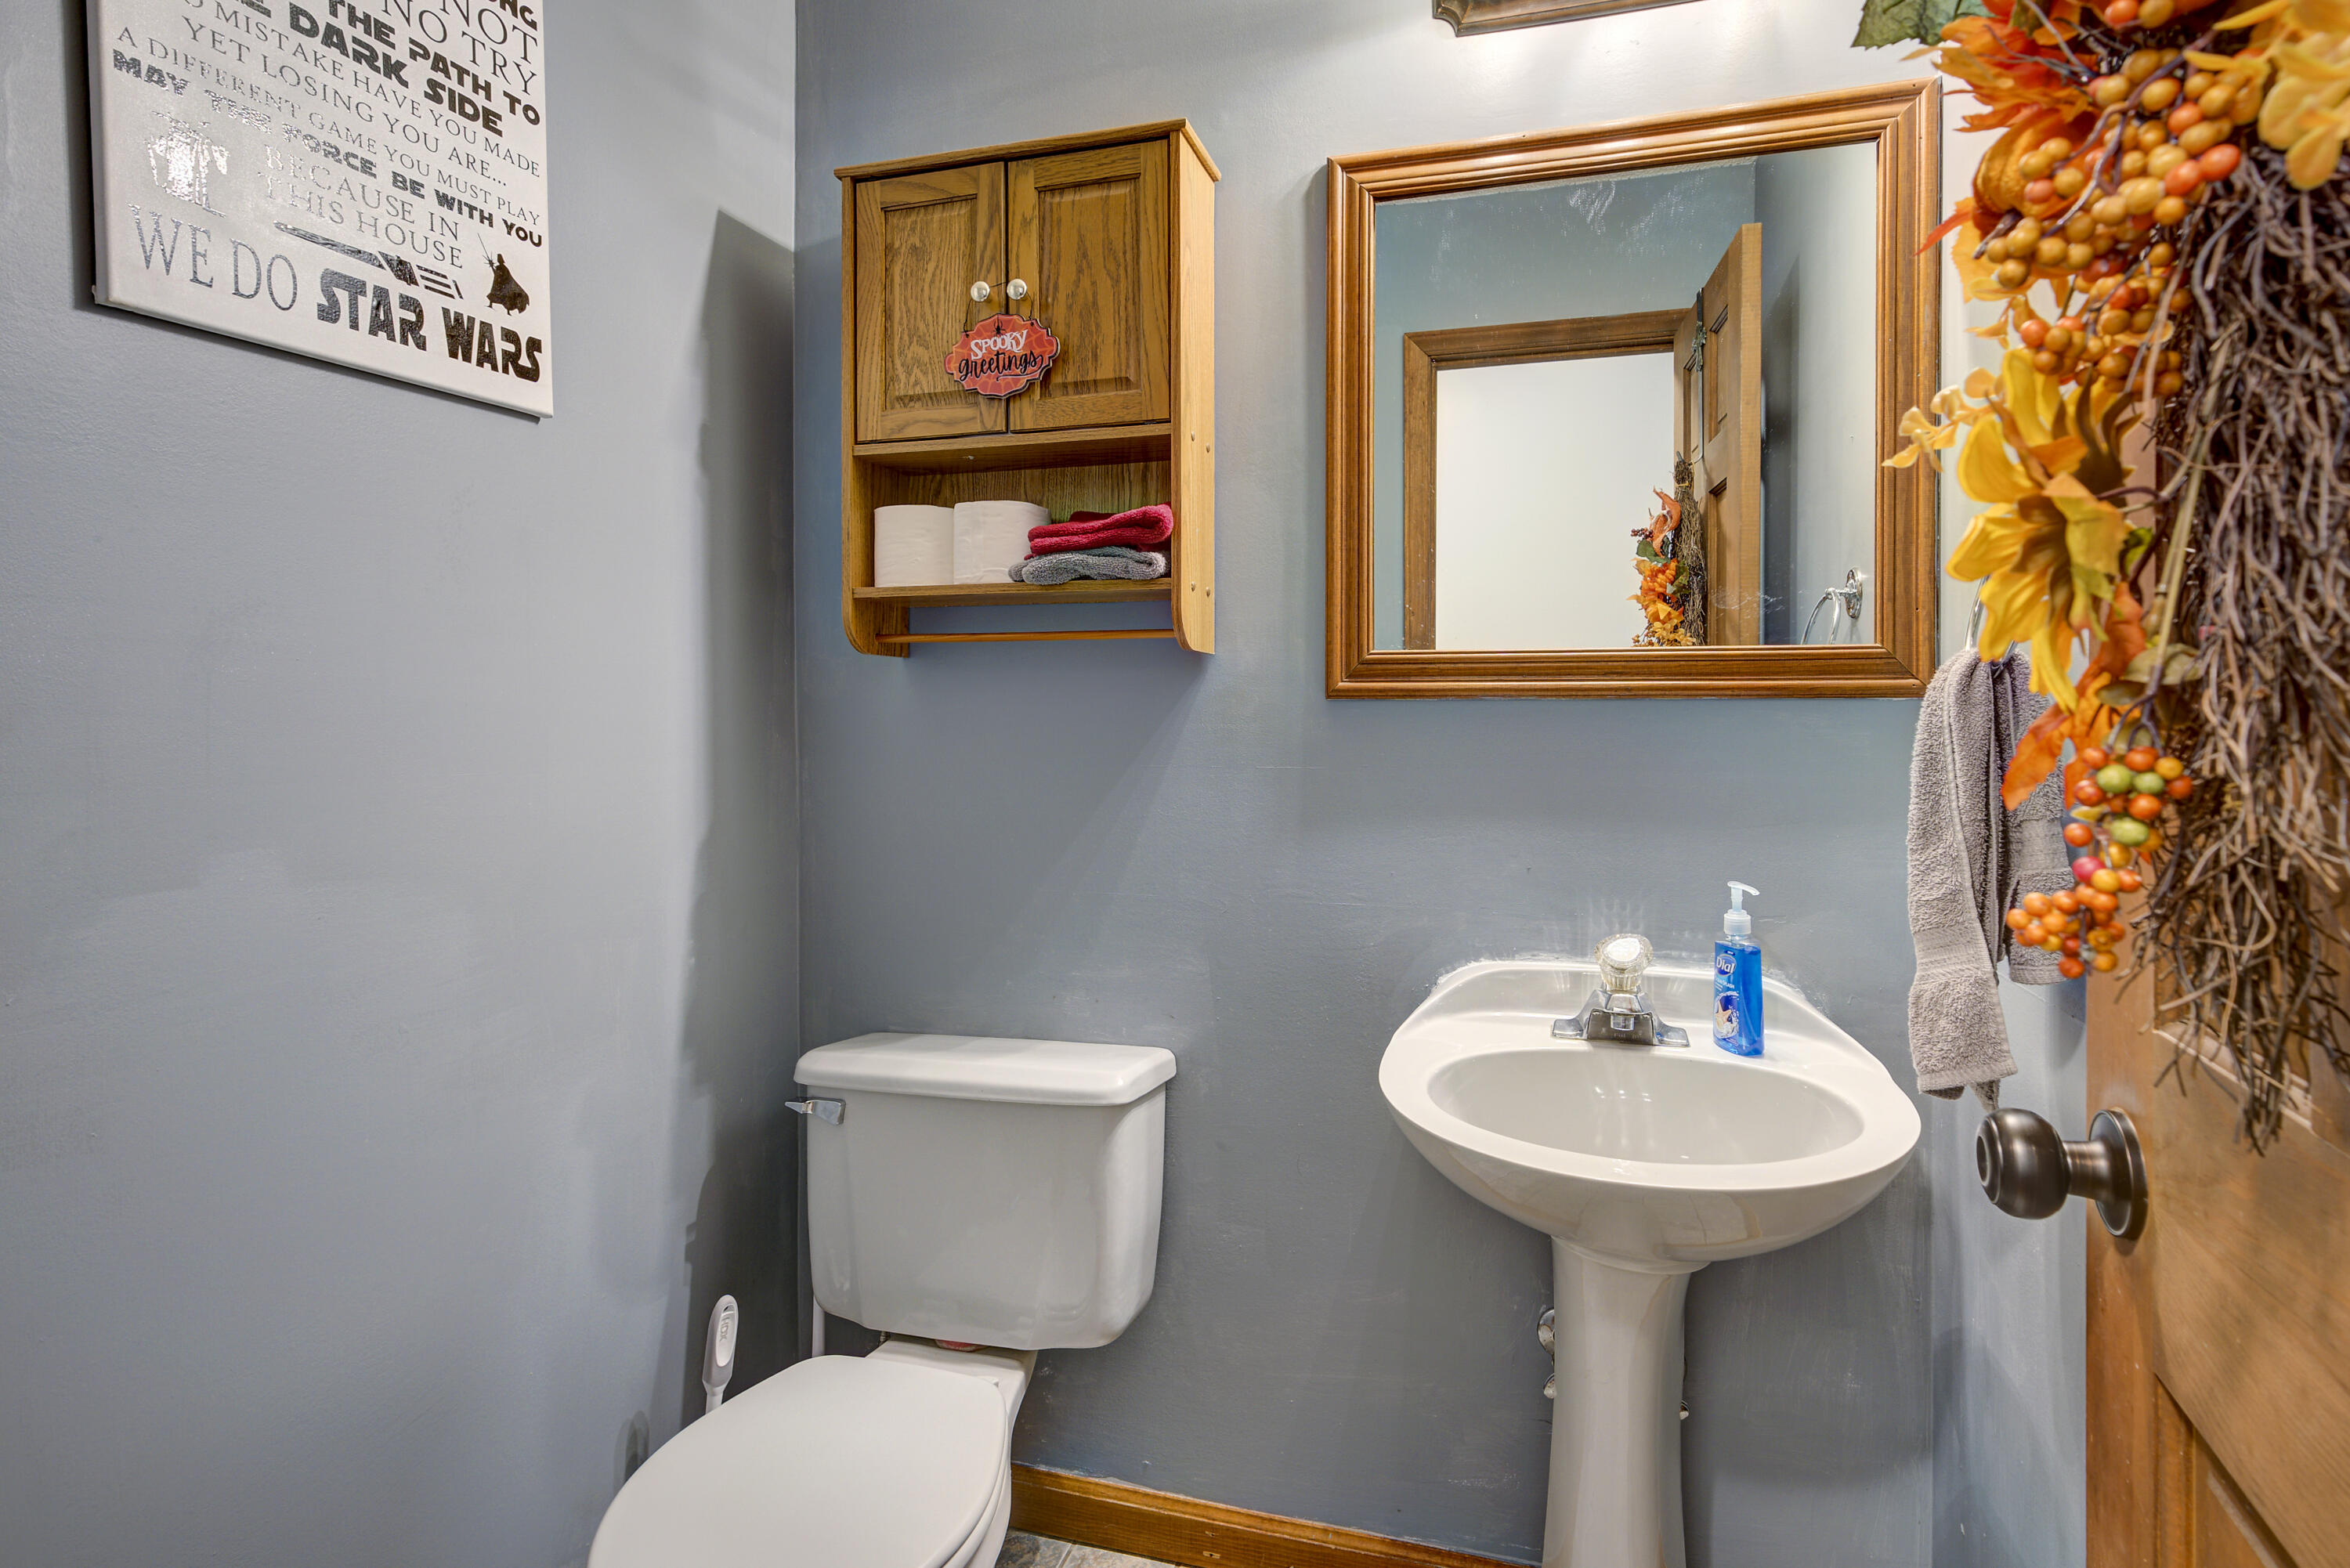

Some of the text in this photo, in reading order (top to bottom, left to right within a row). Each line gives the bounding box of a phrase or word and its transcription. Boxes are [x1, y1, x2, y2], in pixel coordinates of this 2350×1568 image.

[289, 2, 503, 137] DARK SIDE
[329, 0, 540, 125] THE PATH TO
[381, 0, 537, 95] NO TRY
[439, 0, 537, 63] NOT
[489, 0, 537, 31] NG
[118, 27, 540, 226] A DIFFERENT GAME YOU MUST PLAY
[182, 16, 507, 186] YET LOSING YOU ARE...
[215, 1, 344, 80] MISTAKE
[352, 70, 421, 118] HAVE
[429, 108, 476, 144] YOU
[484, 137, 540, 177] MADE
[113, 49, 542, 247] MAY THE FORCE BE WITH YOU
[264, 144, 459, 241] BECAUSE IN
[258, 172, 462, 269] THIS HOUSE
[128, 203, 542, 382] WE DO STAR WARS
[958, 351, 1043, 382] greetings
[1716, 956, 1735, 974] Dial
